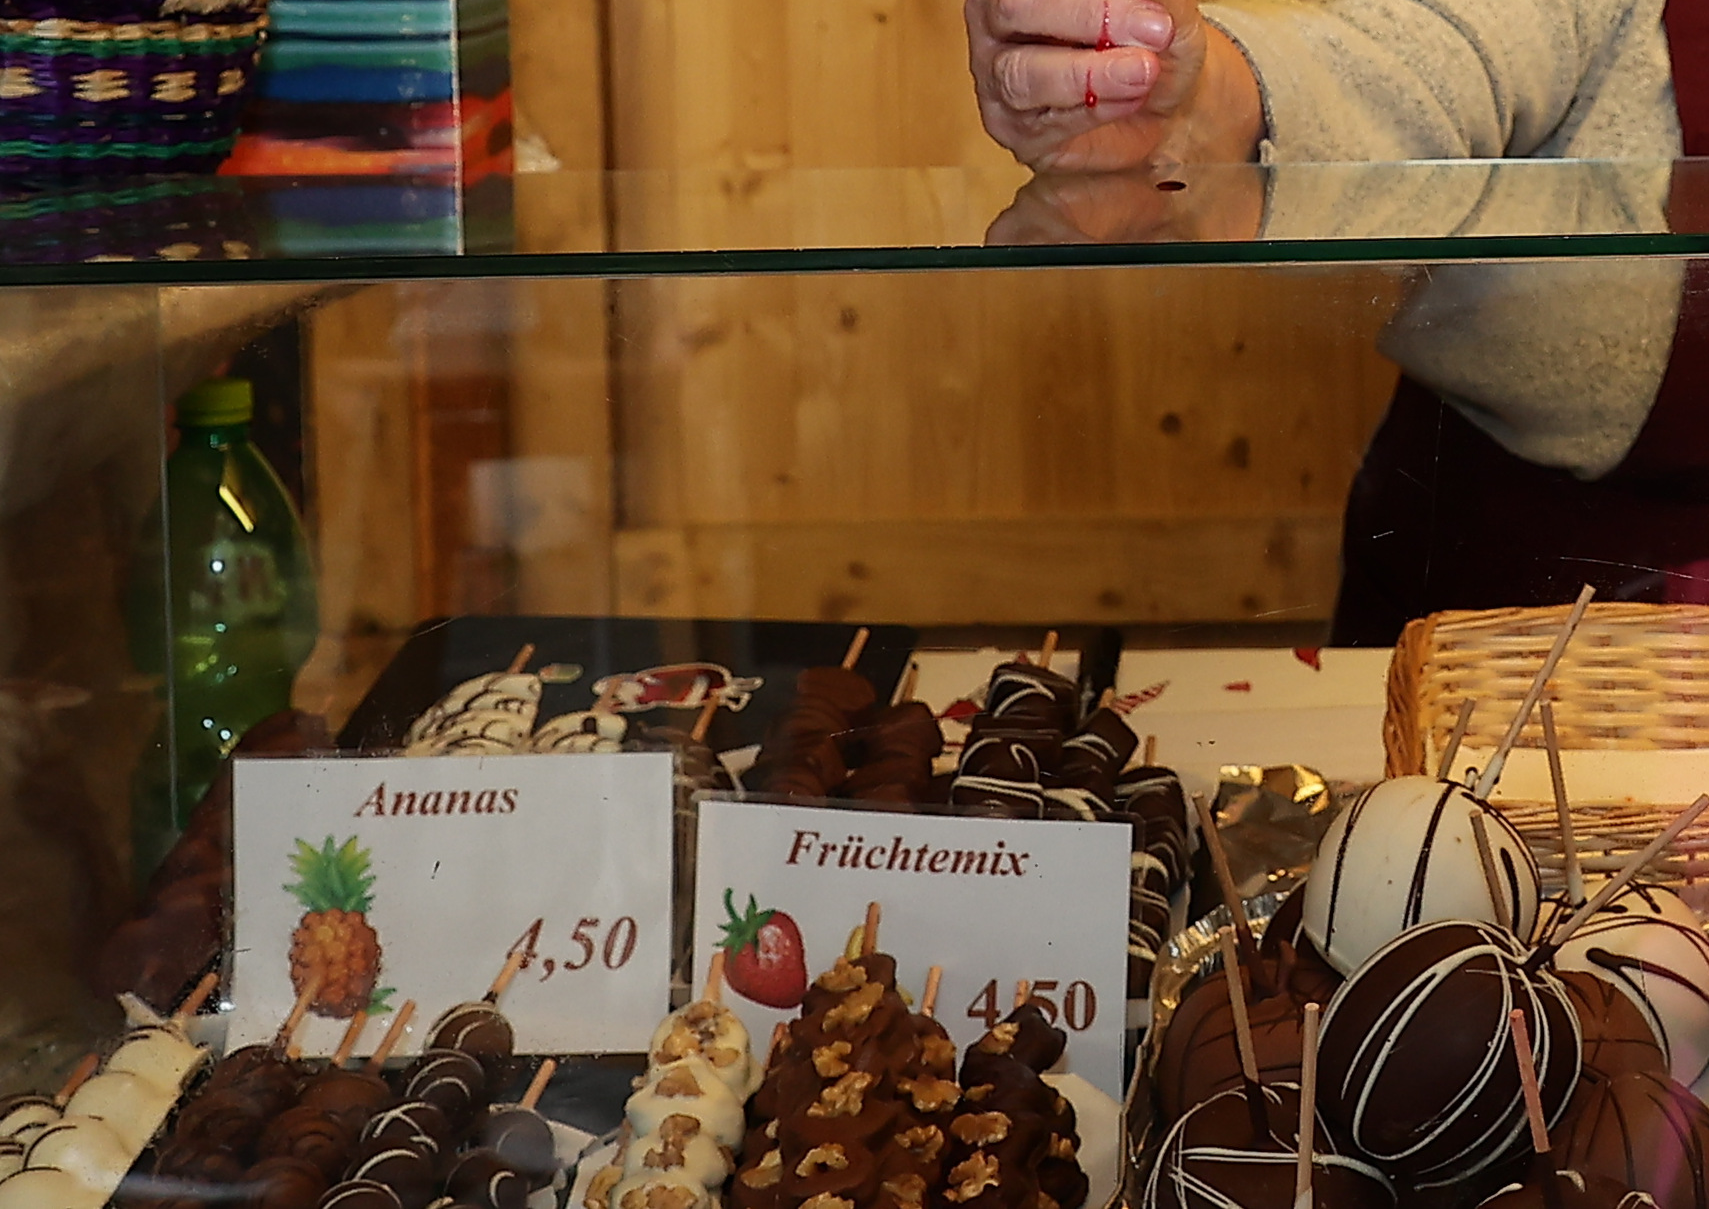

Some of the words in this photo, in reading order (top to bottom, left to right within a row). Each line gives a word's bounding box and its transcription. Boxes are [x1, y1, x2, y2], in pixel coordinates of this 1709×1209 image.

[353, 780, 519, 819] Ananas
[785, 829, 1031, 877] Früchtemix
[505, 916, 638, 983] 4,50
[967, 978, 1097, 1032] 450
